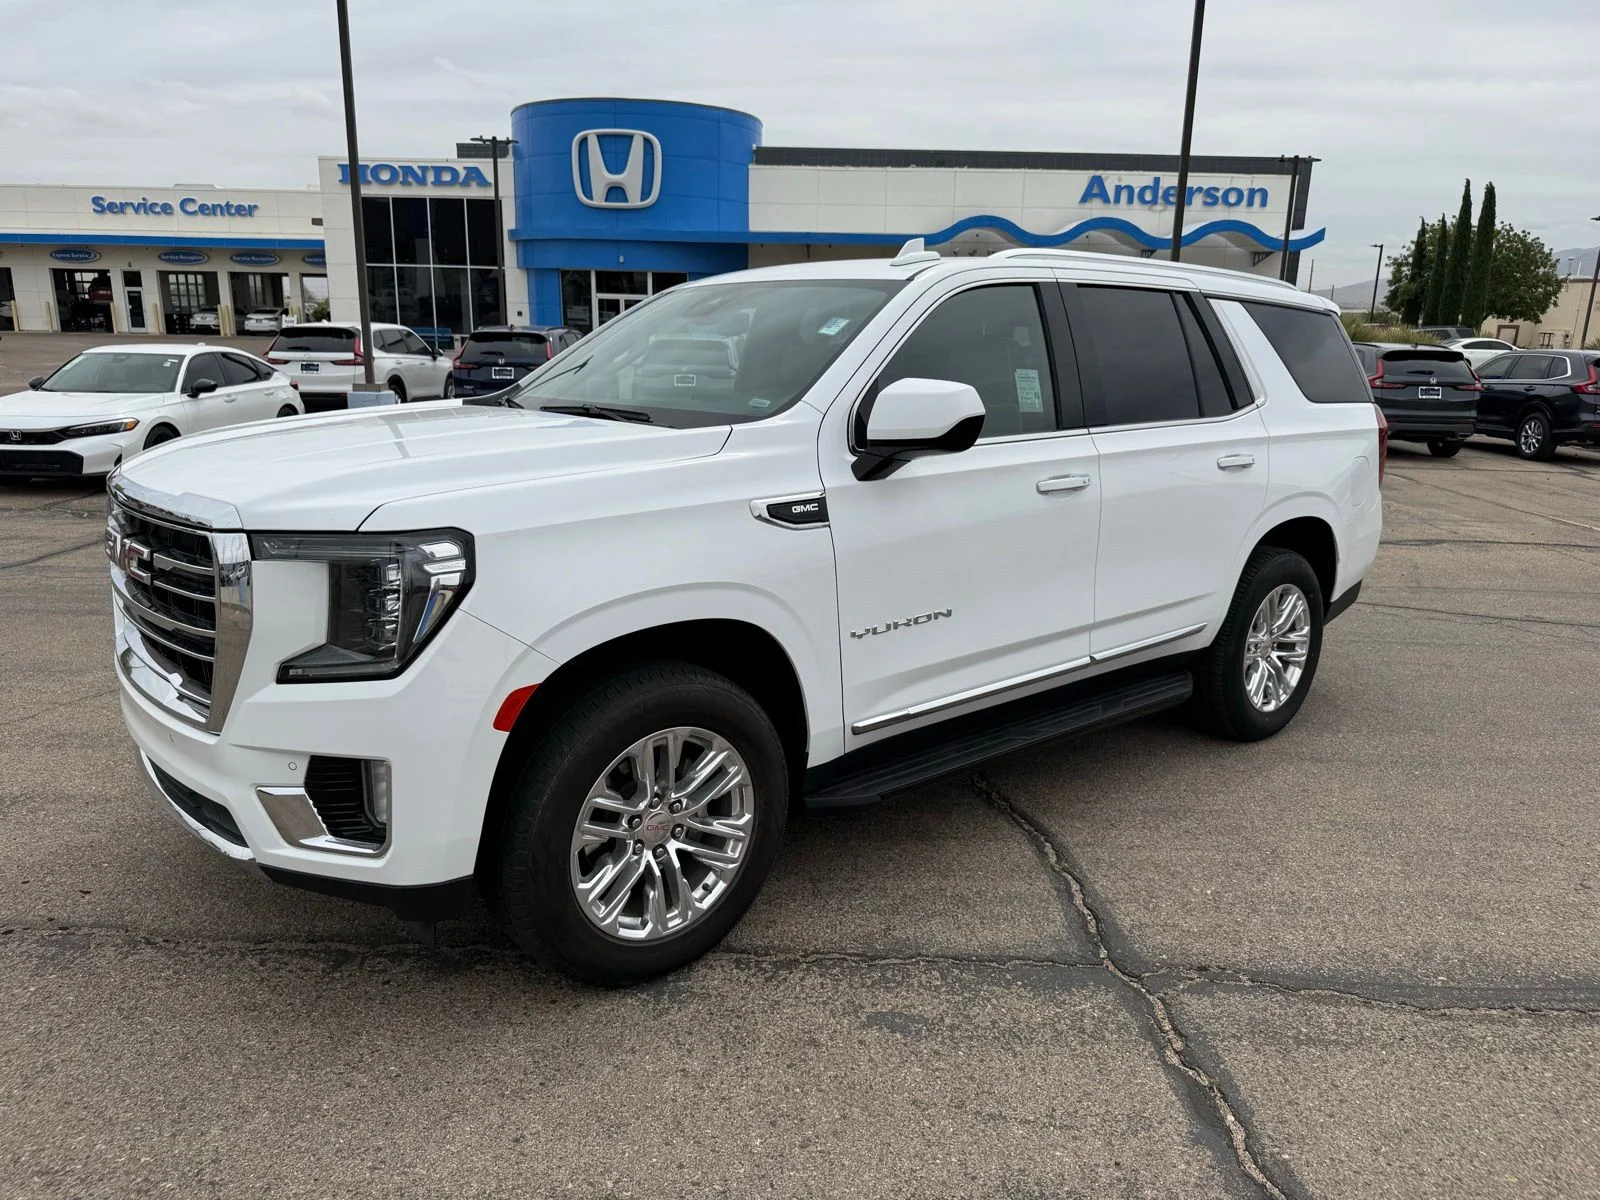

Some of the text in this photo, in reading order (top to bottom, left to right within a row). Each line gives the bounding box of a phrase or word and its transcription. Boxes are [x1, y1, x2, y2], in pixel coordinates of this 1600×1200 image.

[337, 163, 492, 187] HONDA
[1078, 175, 1269, 208] Anderson
[91, 195, 258, 217] Service Center
[792, 503, 819, 513] GMC
[850, 607, 953, 639] YUKON
